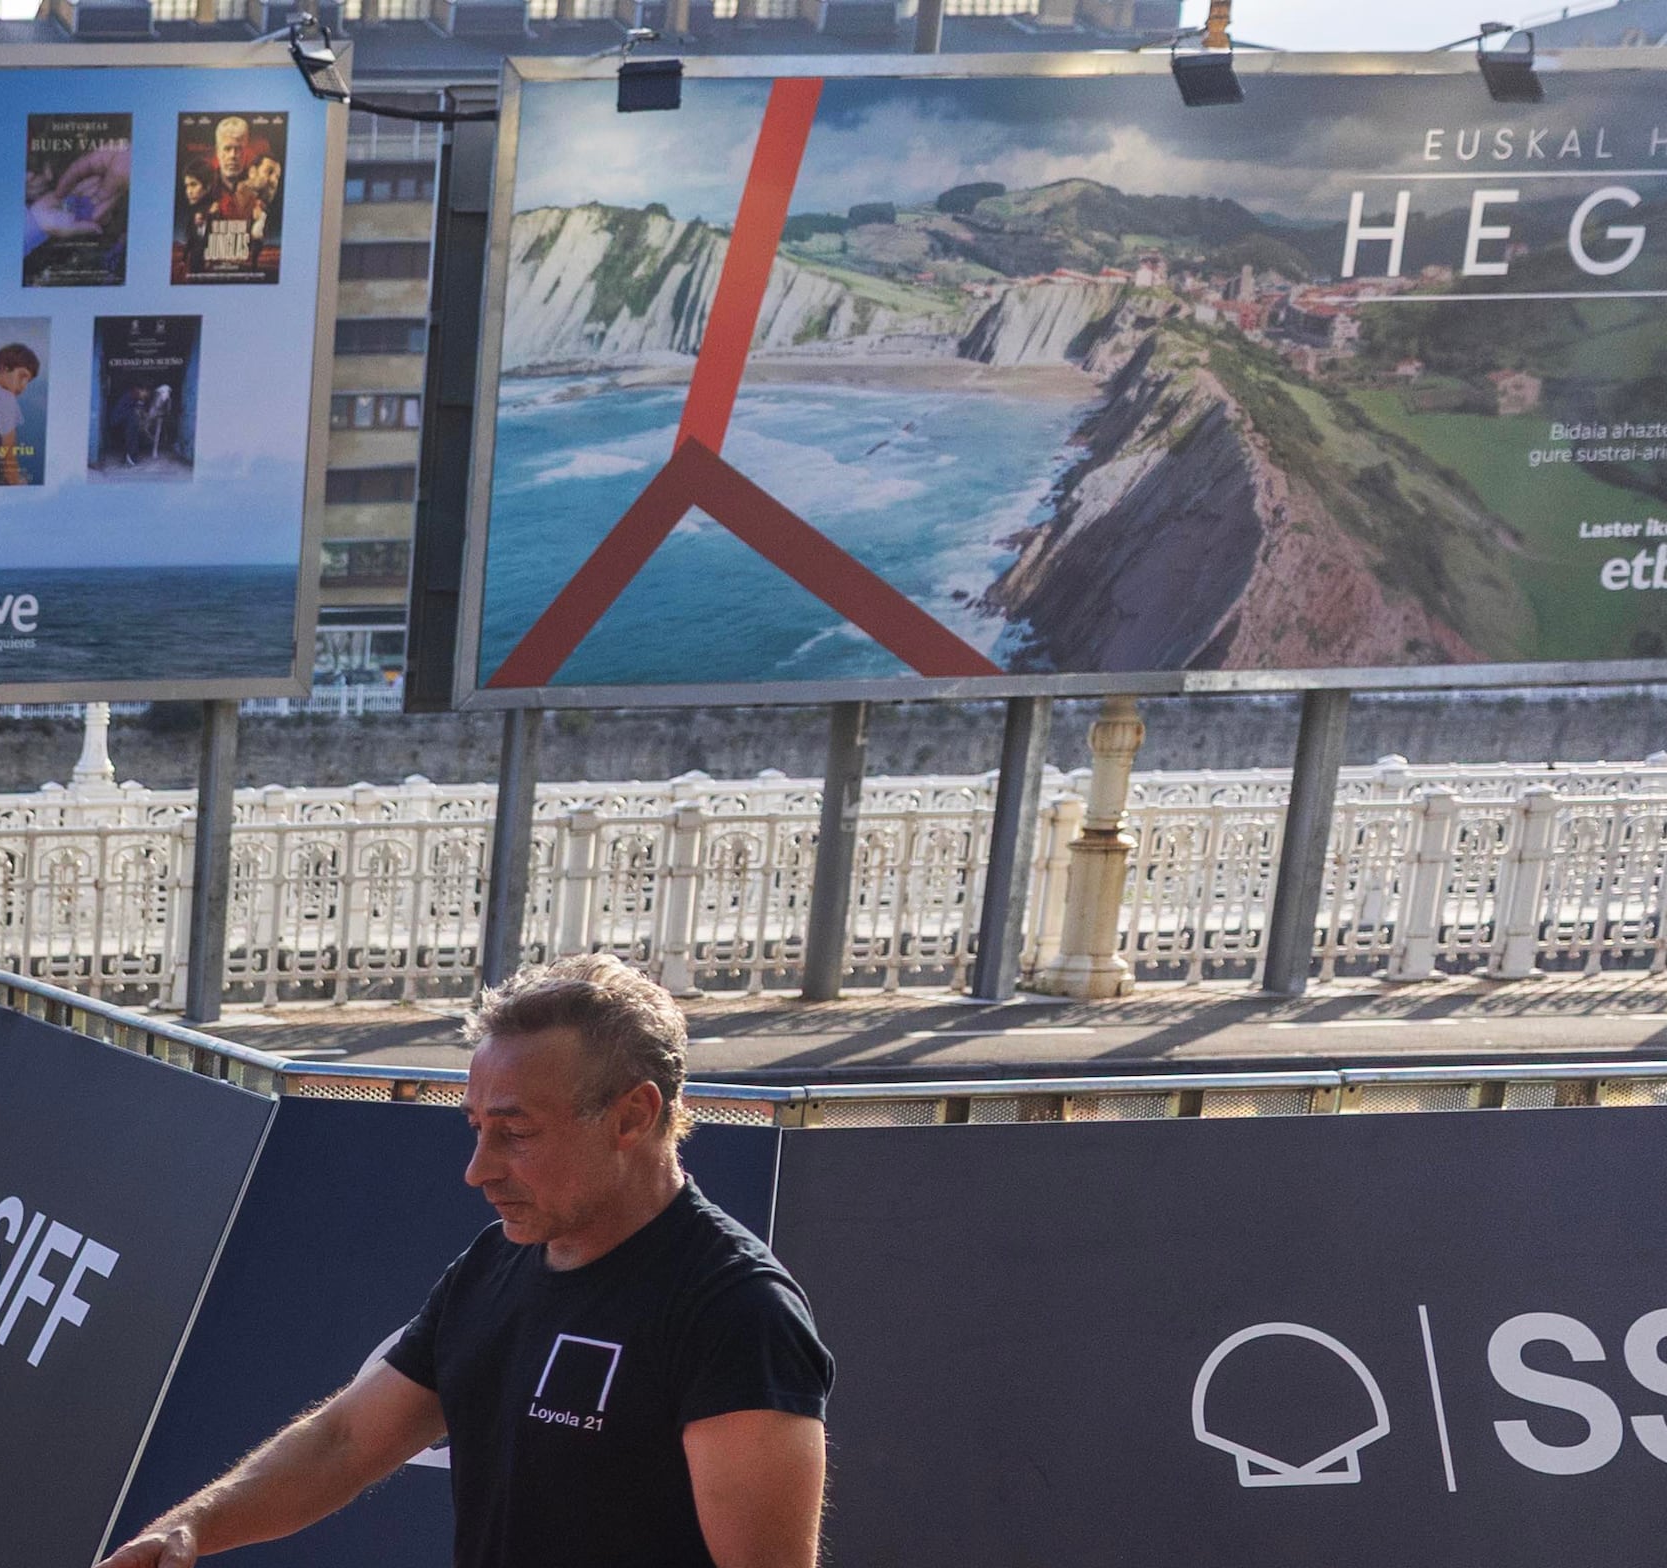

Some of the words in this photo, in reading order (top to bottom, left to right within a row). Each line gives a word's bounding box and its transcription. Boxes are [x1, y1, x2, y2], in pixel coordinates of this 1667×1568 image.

[31, 138, 73, 151] BUEN
[78, 138, 129, 151] VALLE
[1423, 127, 1613, 160] EUSKAL
[1341, 186, 1646, 278] HEG
[1550, 422, 1607, 440] Bidaia
[1528, 449, 1572, 467] gure
[1579, 521, 1643, 539] Laster
[528, 1402, 580, 1427] Loyola
[583, 1415, 604, 1432] 21
